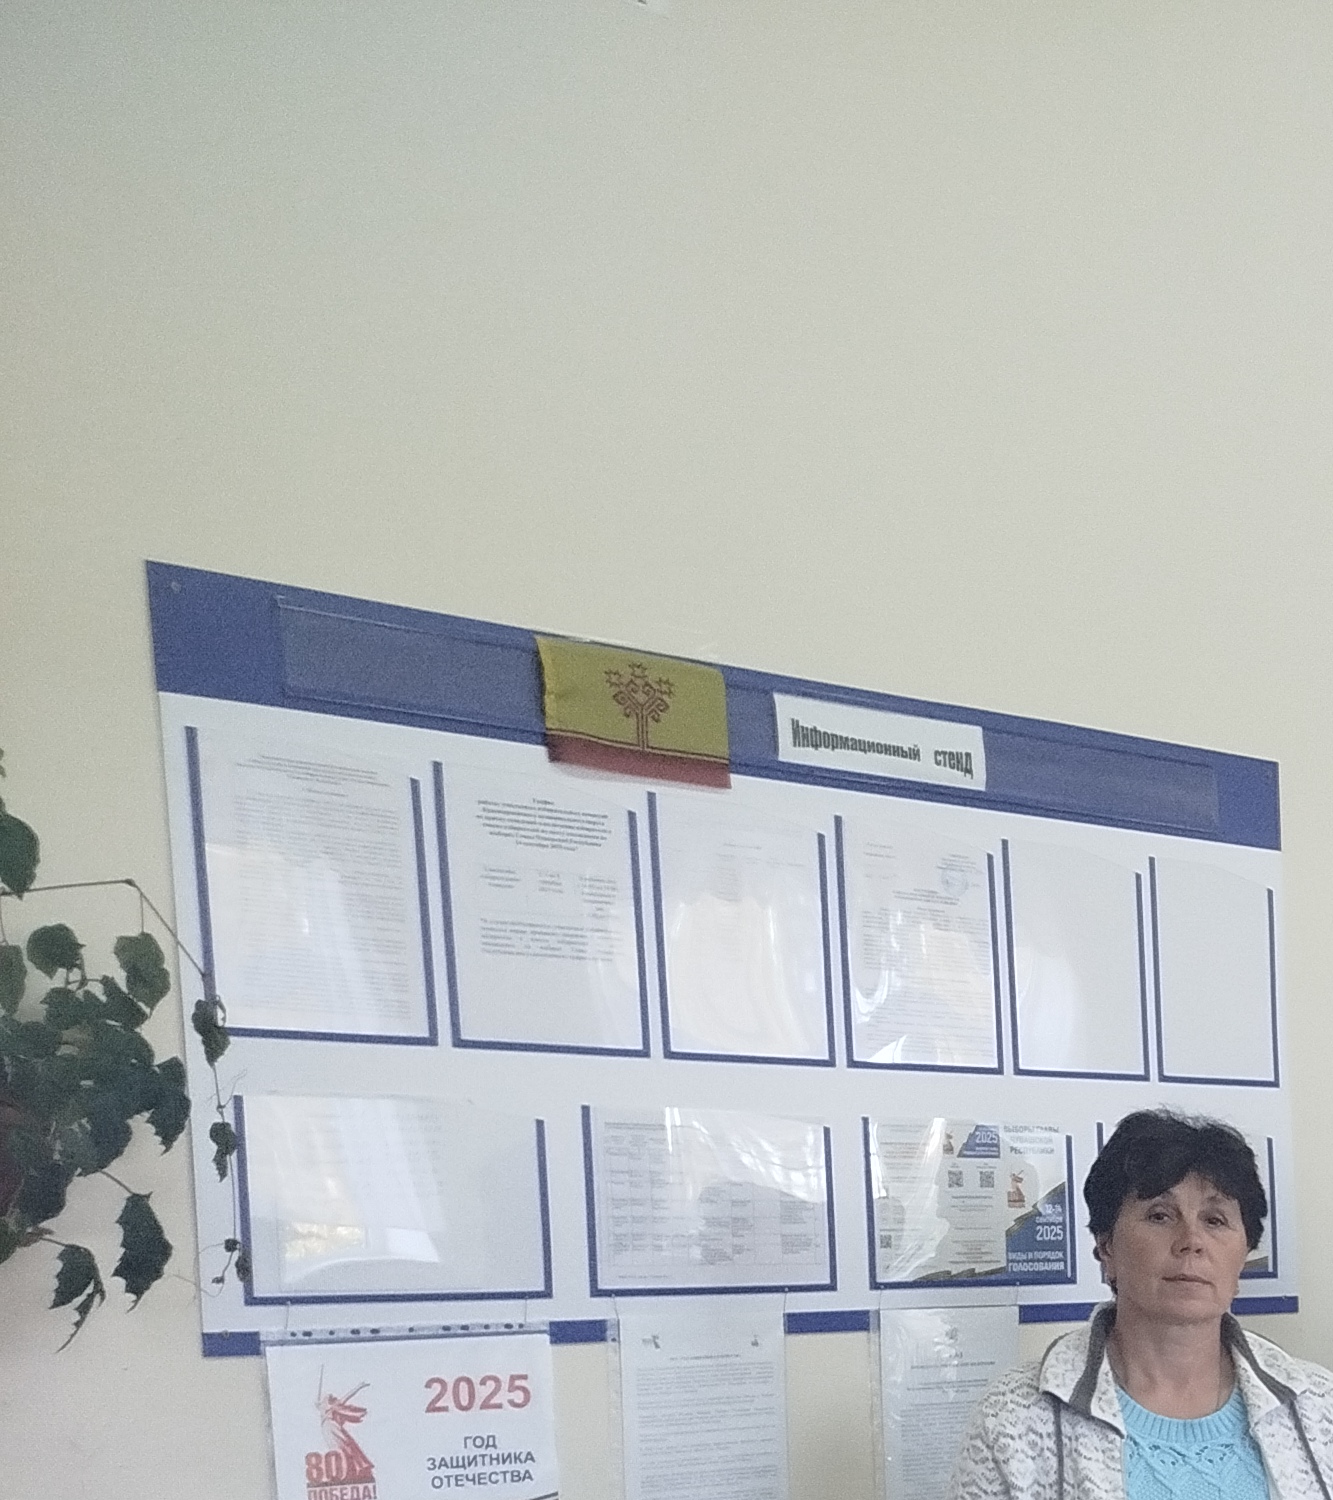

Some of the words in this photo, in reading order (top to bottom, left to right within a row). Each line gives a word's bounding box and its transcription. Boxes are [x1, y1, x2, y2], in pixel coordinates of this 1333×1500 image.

[791, 718, 921, 762] Информационный
[934, 749, 974, 779] стенд
[1036, 1225, 1064, 1241] 2025
[1008, 1261, 1065, 1272] ГОЛОСОВАНИЯ
[424, 1373, 531, 1414] 2025
[463, 1435, 498, 1451] ГОД
[426, 1450, 536, 1471] ЗАЩИТНИКА
[431, 1469, 533, 1490] ОТЕЧЕСТВА
